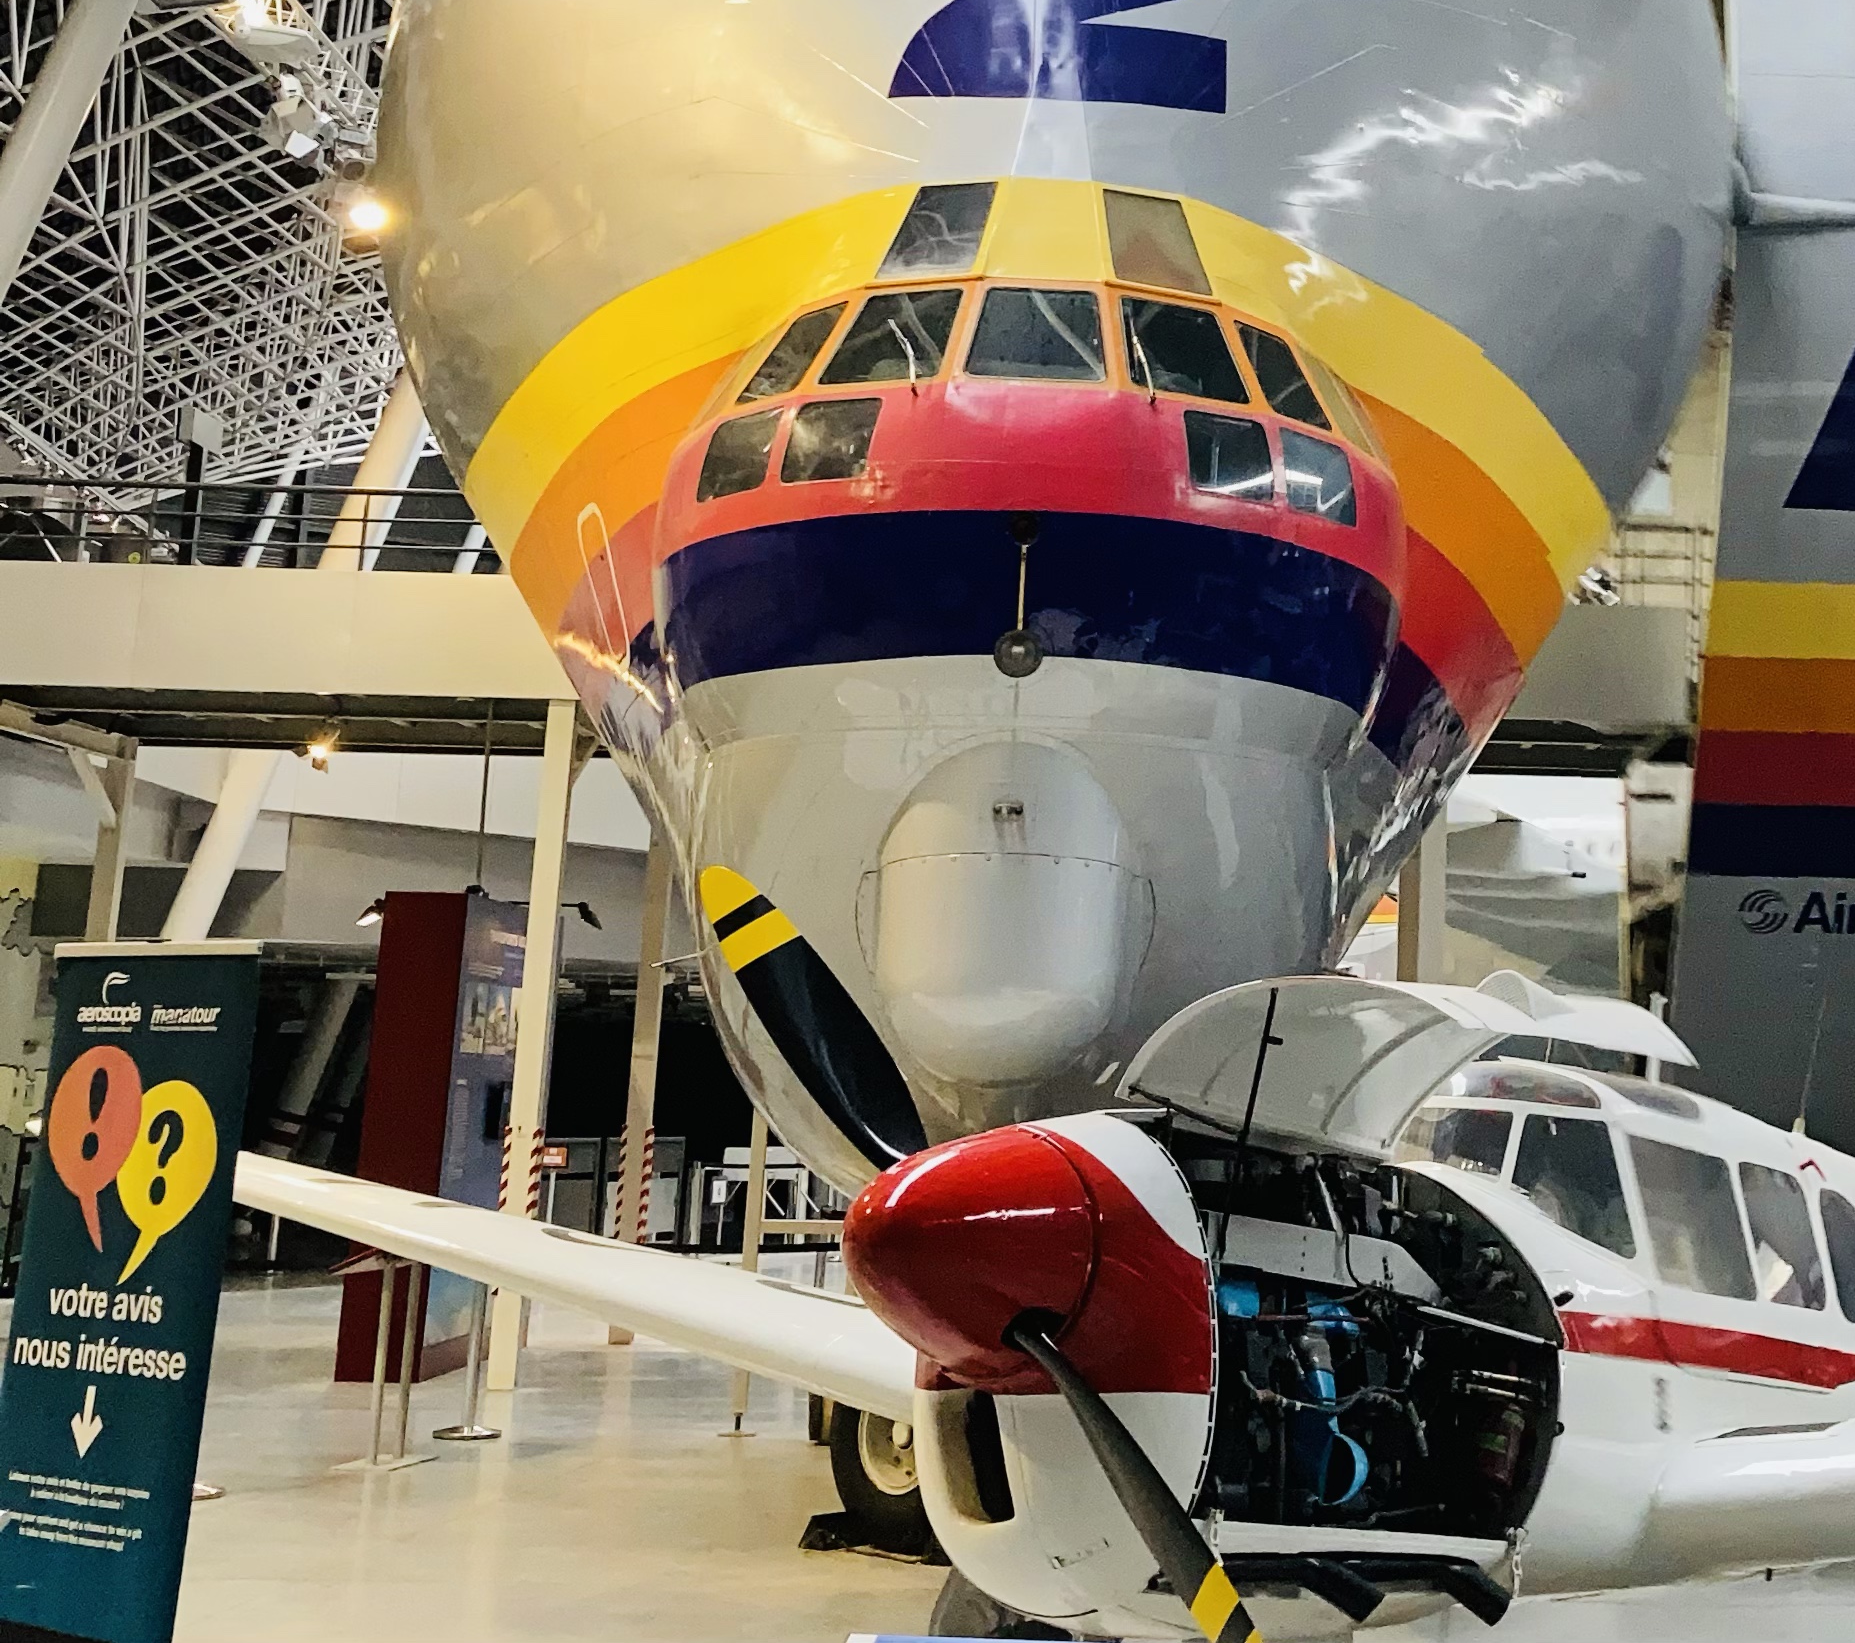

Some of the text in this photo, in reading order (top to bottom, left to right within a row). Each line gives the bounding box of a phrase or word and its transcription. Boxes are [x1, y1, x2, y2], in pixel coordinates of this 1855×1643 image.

[50, 1283, 163, 1324] votre avis
[14, 1333, 187, 1381] nous intéresse
